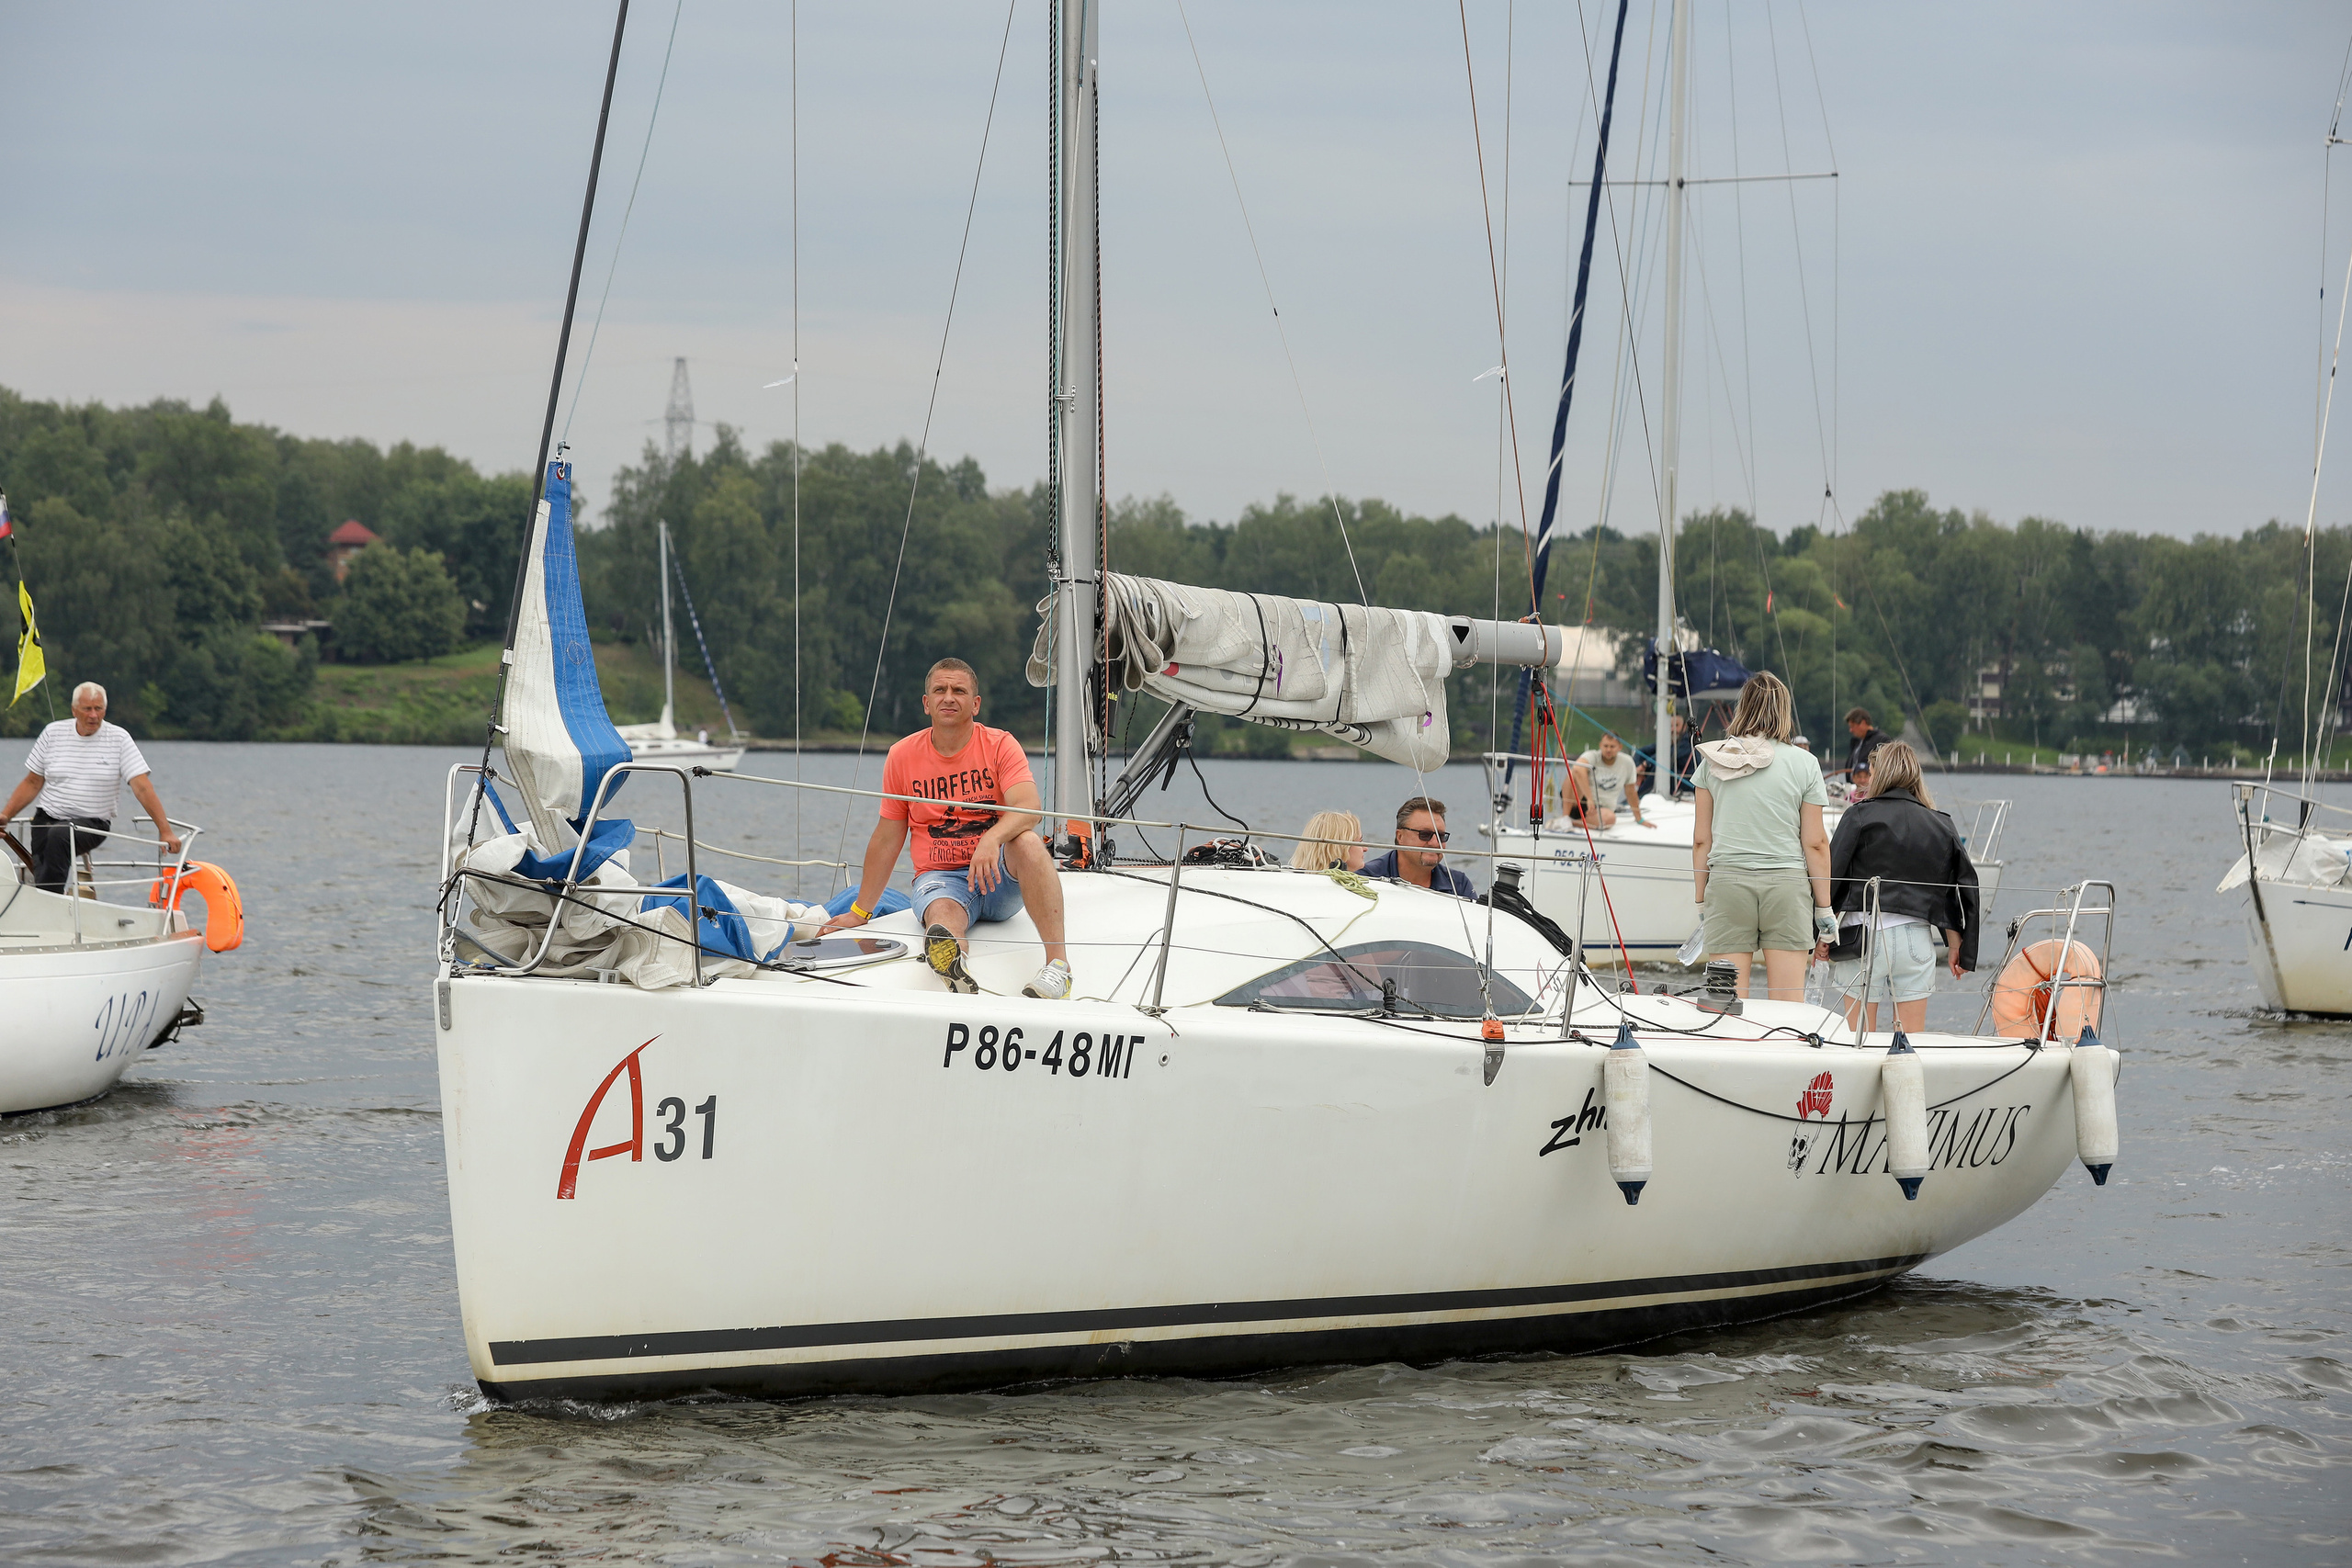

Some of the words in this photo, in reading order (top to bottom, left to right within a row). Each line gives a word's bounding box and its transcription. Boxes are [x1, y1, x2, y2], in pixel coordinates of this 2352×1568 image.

[912, 768, 994, 803] SURFERS
[929, 846, 956, 863] VENICE
[943, 1022, 1146, 1079] Р86-48МГ
[1539, 1087, 1608, 1157] zhi
